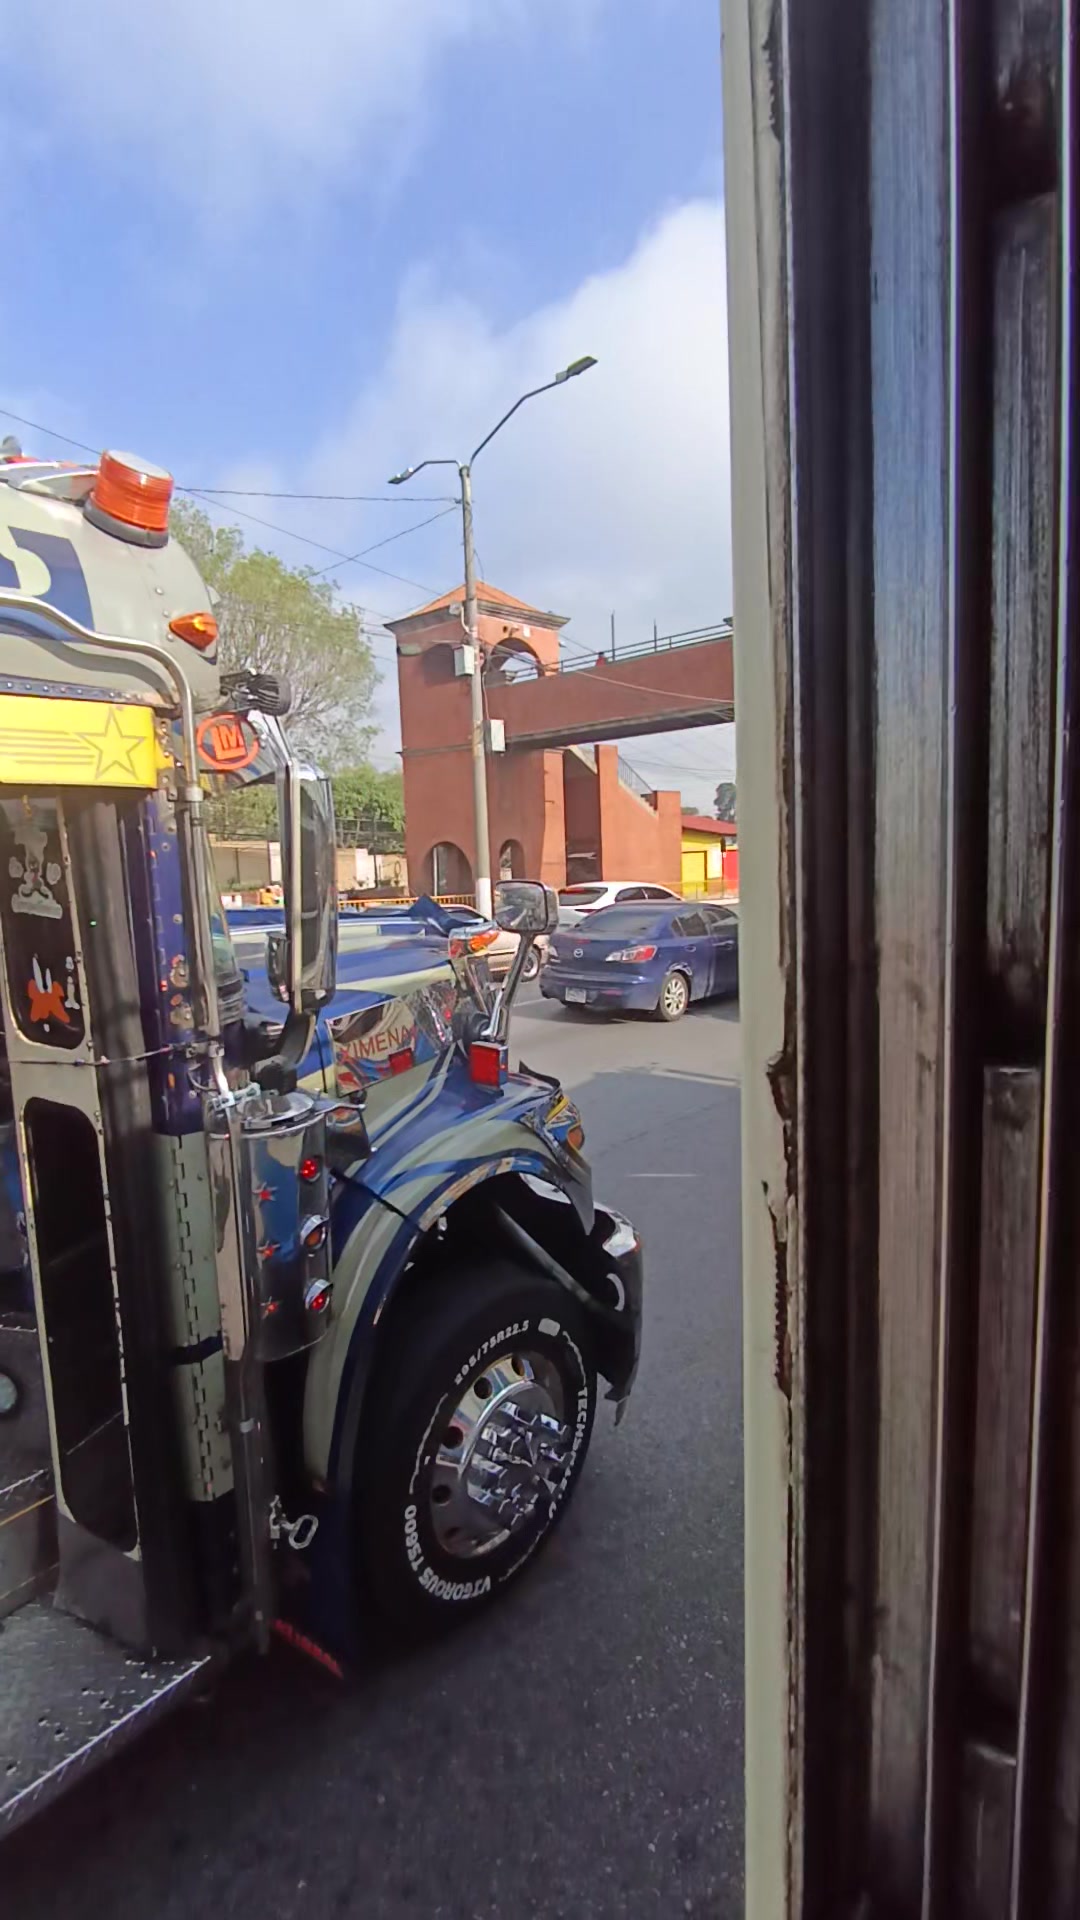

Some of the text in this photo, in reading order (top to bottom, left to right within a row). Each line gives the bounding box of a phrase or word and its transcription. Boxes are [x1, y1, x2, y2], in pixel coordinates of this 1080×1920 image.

[338, 1026, 412, 1060] XIMENA
[403, 1505, 492, 1601] VIGOROUS TS600
